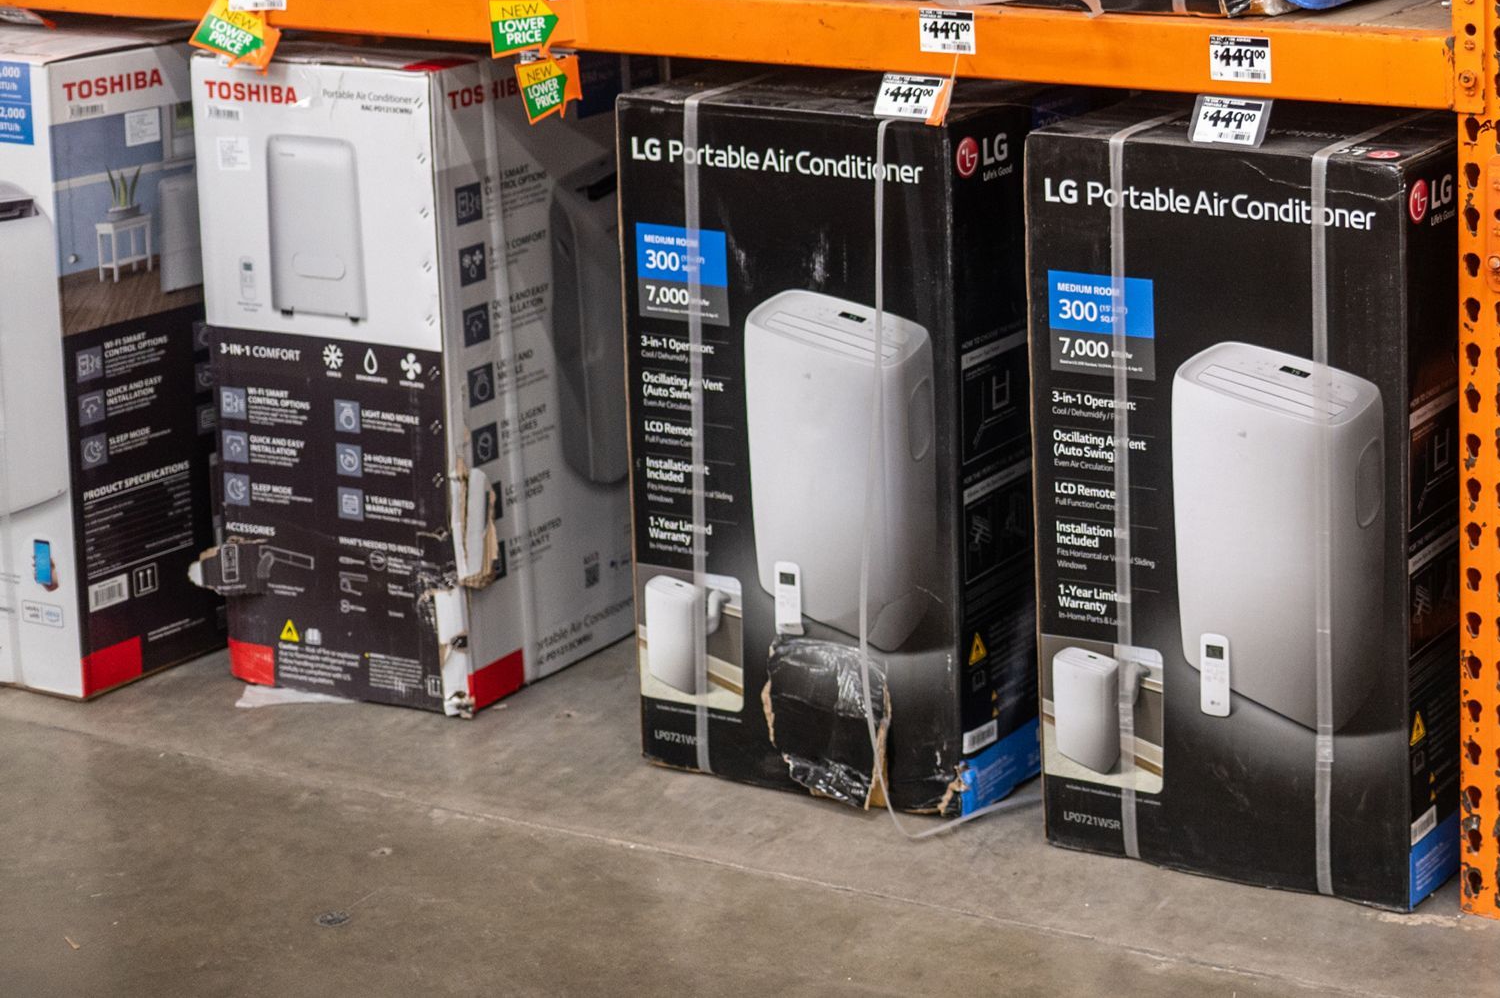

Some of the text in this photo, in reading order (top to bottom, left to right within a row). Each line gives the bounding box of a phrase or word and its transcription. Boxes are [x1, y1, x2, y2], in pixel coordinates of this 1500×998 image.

[223, 7, 257, 31] NEW
[502, 3, 539, 18] NEW
[210, 19, 253, 45] LOWER
[499, 17, 546, 34] LOWER
[208, 33, 243, 54] PRICE
[506, 29, 542, 45] PRICE
[62, 68, 163, 101] TOSHIBA
[205, 81, 297, 105] TOSHIBA
[323, 89, 412, 104] Portable Air Conditioner
[984, 133, 1008, 164] LG
[631, 137, 923, 184] LG Portable Air Conditioner
[1432, 174, 1452, 207] LG
[1045, 178, 1376, 231] LG Portable Air Conditoner
[646, 249, 679, 271] 300
[646, 285, 689, 305] 7,000
[1059, 299, 1097, 321] 300
[220, 343, 301, 362] 3-IN-1 COMFORT
[1059, 337, 1109, 358] 7,000
[84, 461, 189, 501] PRODUCT SPECIFICATIONS
